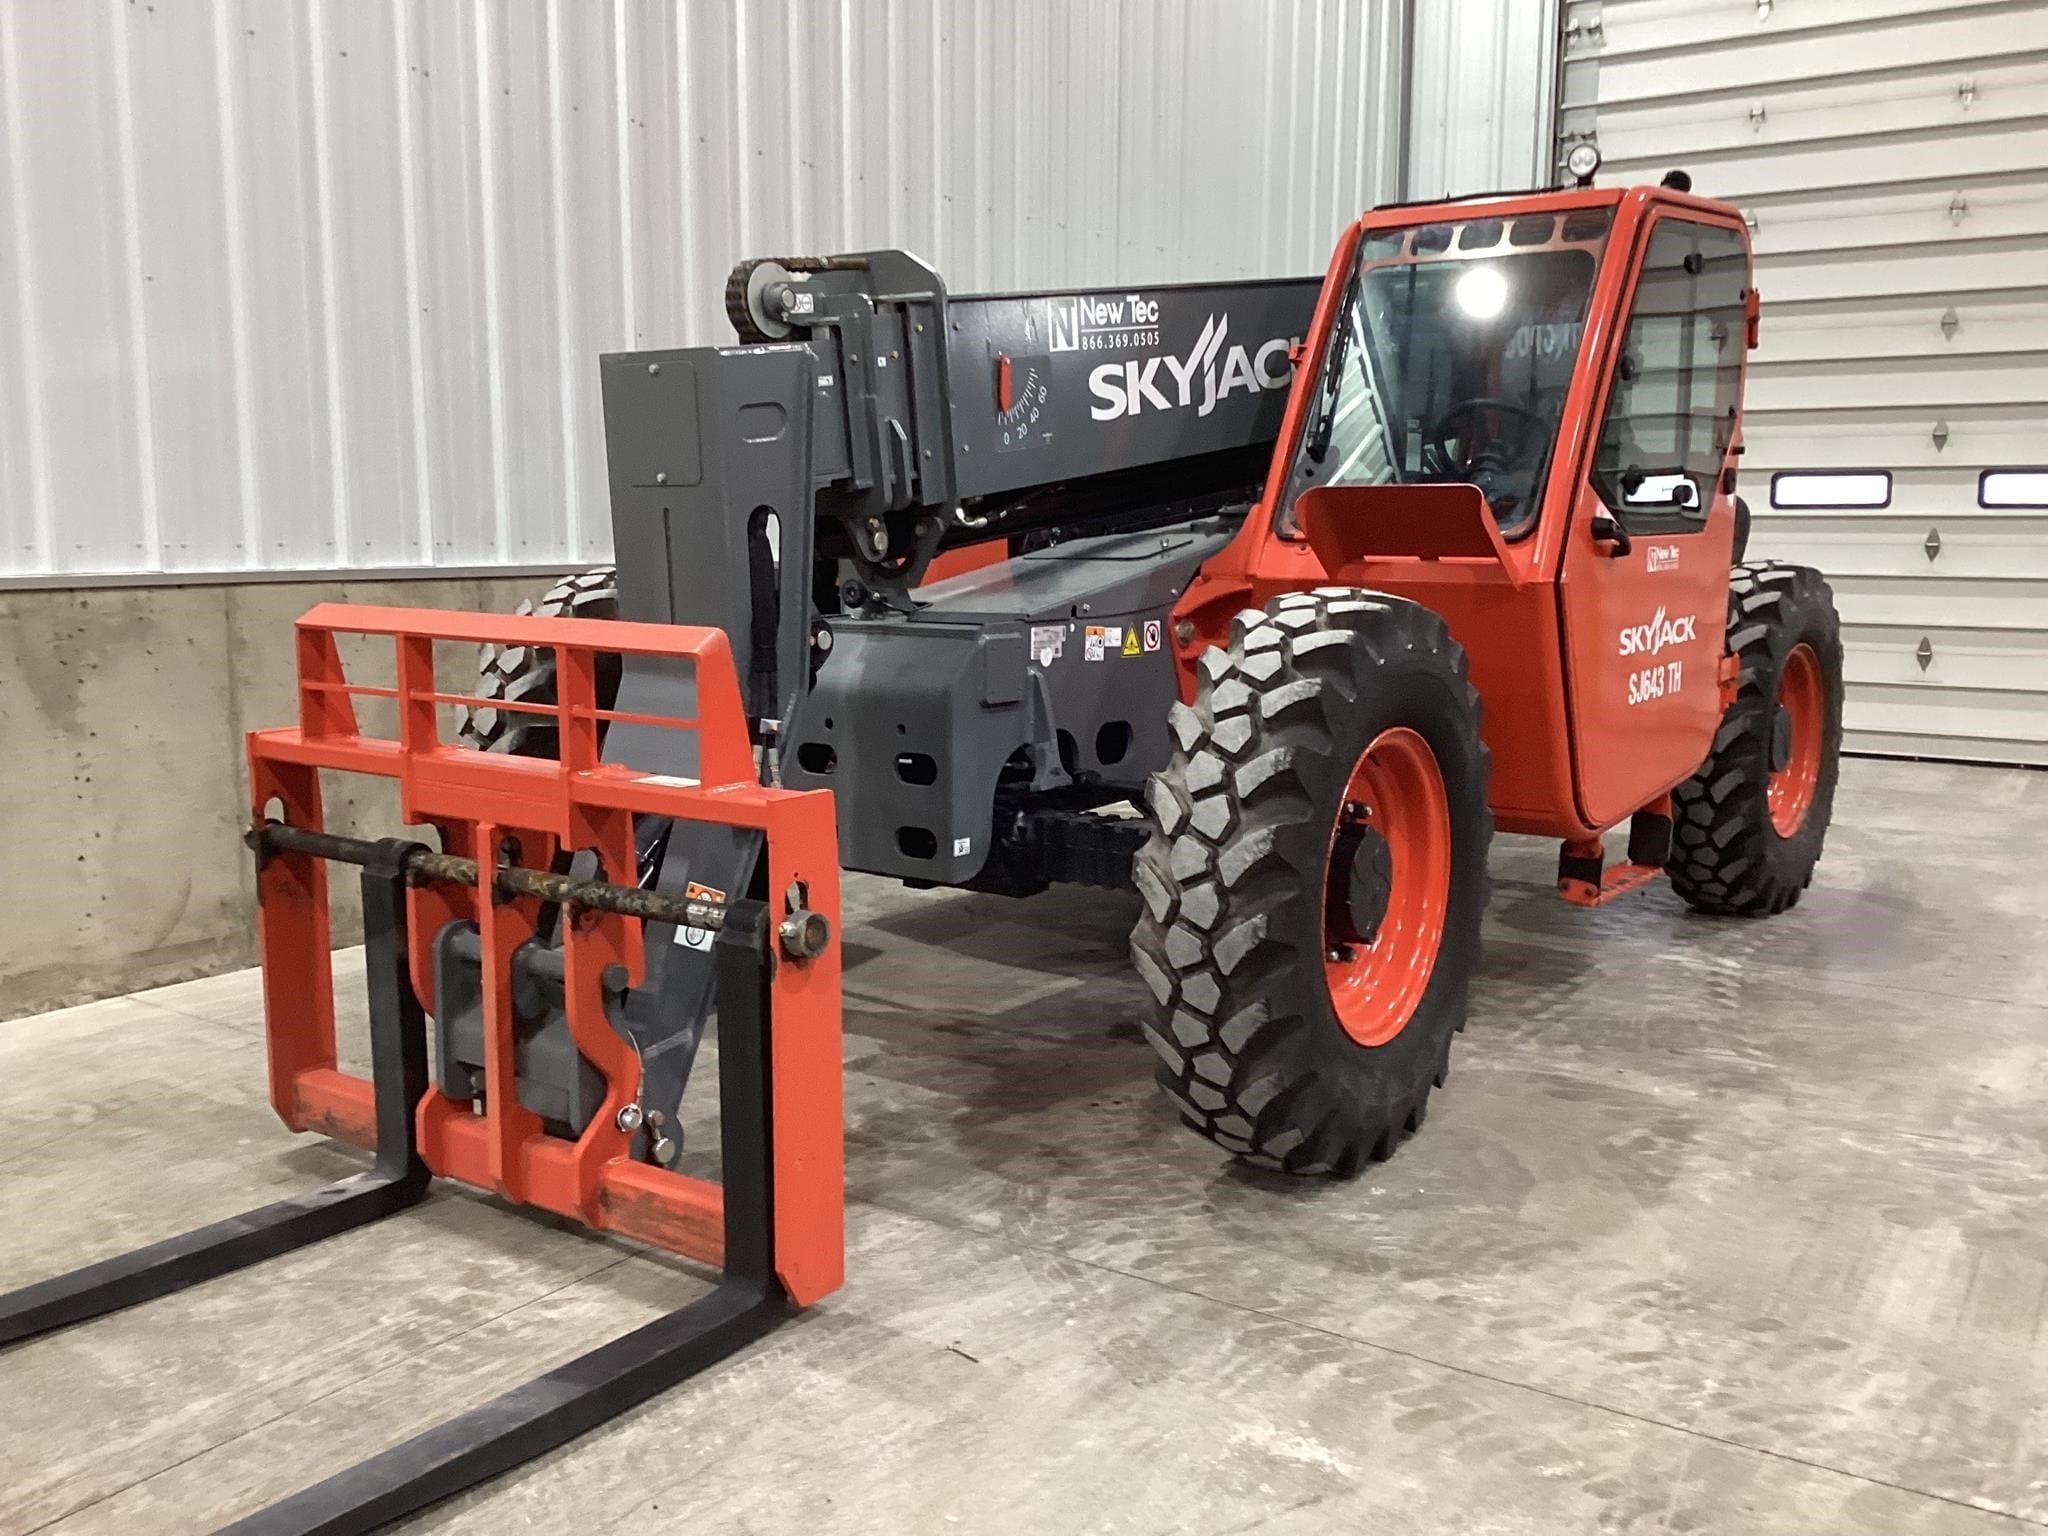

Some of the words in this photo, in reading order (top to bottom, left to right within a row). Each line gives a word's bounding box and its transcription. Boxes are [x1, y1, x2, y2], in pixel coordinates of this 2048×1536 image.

[1080, 296, 1124, 326] New
[1126, 295, 1159, 323] Tec
[1082, 332, 1160, 350] 866.369.0505
[1088, 313, 1299, 421] SKYJAC
[1038, 386, 1047, 403] 60
[1030, 407, 1039, 423] 40
[1003, 432, 1010, 445] 0
[1016, 423, 1027, 439] 20
[1618, 606, 1697, 656] SKYJACK
[1628, 665, 1665, 705] SJ643
[1667, 661, 1682, 693] TH
